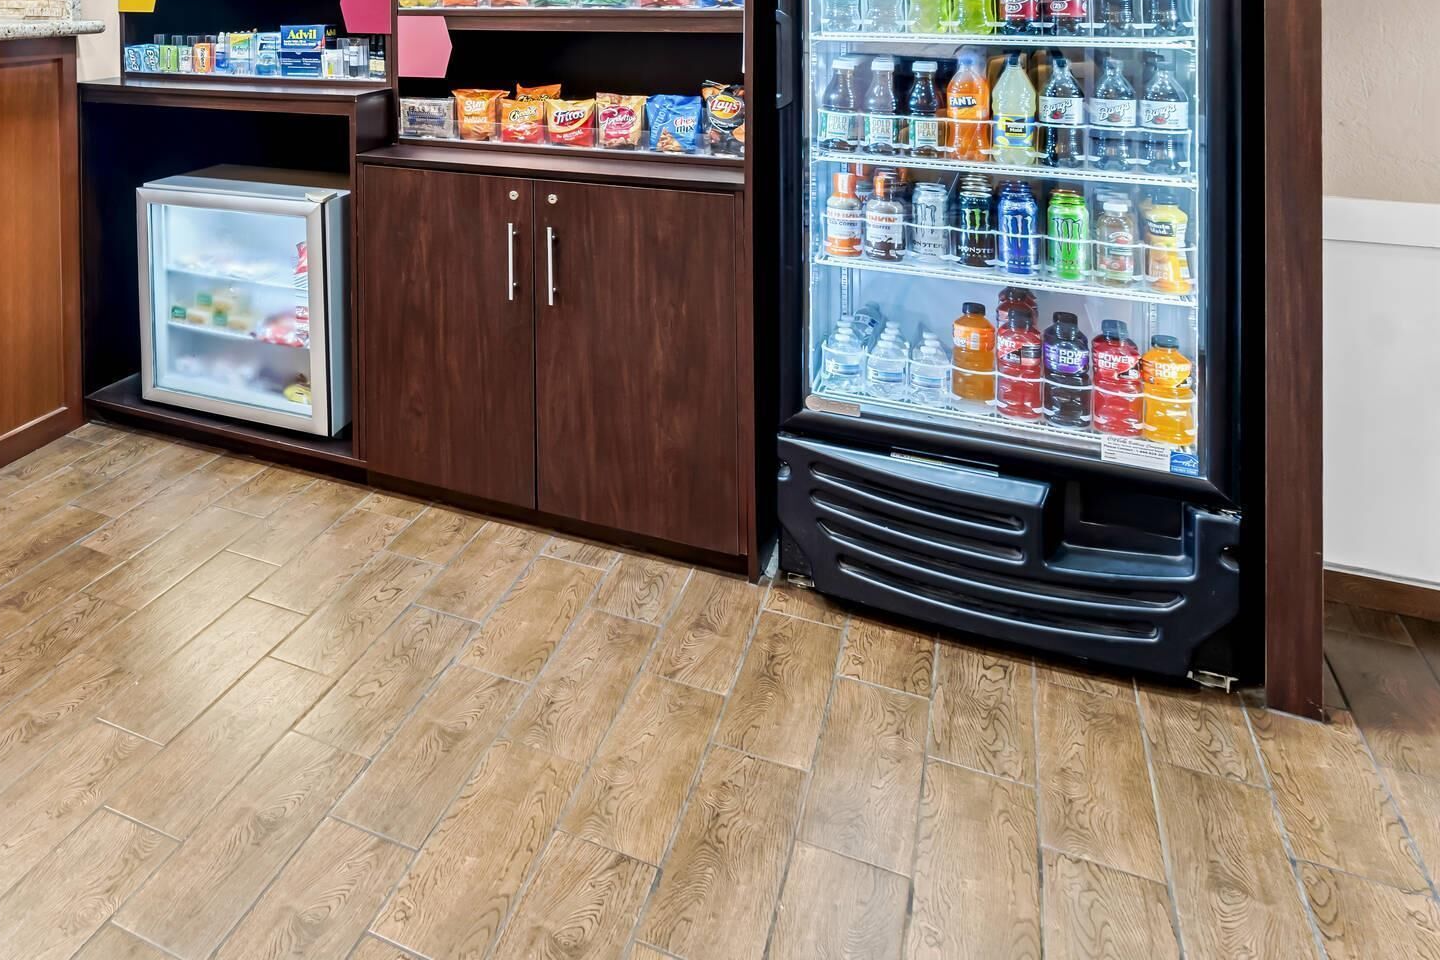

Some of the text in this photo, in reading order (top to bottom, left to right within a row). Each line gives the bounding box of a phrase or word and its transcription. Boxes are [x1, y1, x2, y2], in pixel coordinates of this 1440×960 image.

[287, 29, 317, 40] Advil
[949, 96, 977, 107] FANTA
[872, 119, 891, 127] GOLD
[917, 121, 937, 129] GOLD
[872, 127, 891, 135] PEAK
[912, 240, 944, 248] ONSTER
[958, 245, 994, 254] MONSTE
[1060, 349, 1089, 359] POWE
[1098, 352, 1135, 365] POWER
